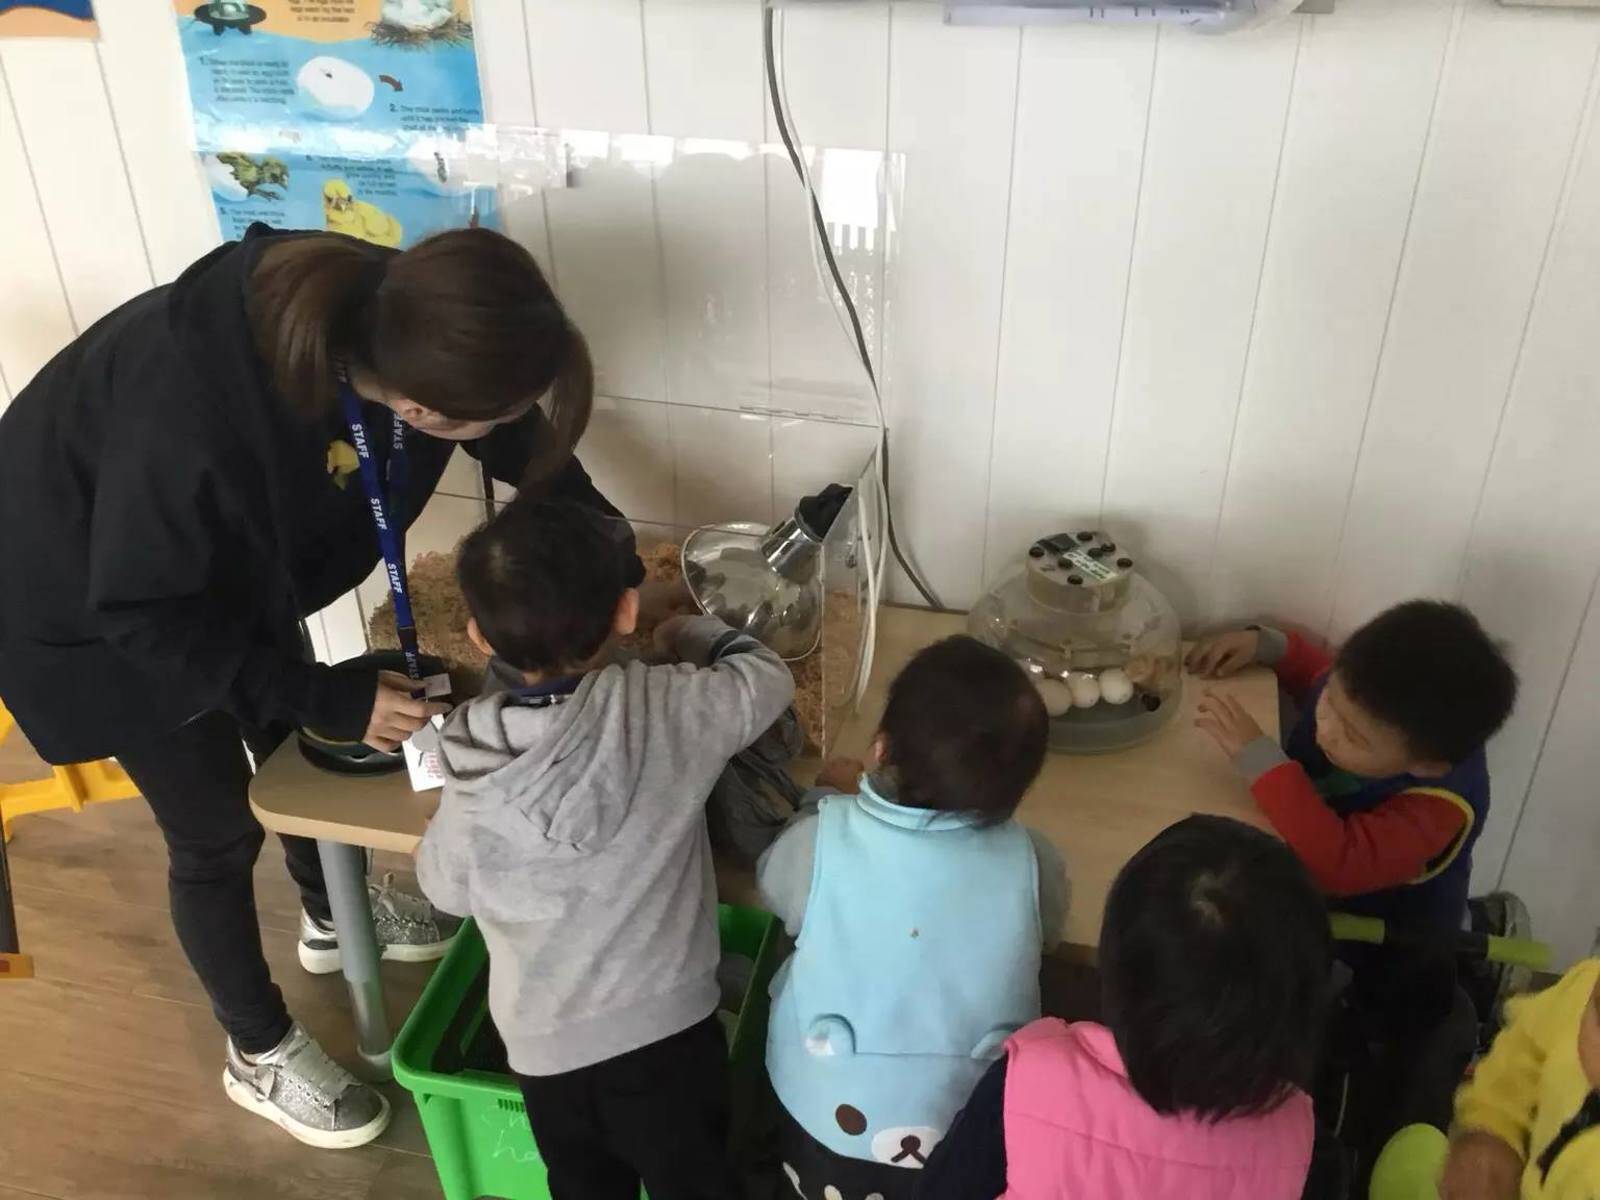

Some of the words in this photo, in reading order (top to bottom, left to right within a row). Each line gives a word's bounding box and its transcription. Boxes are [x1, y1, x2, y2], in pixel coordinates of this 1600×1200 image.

[351, 423, 369, 458] STAFF
[370, 498, 388, 530] STAFF
[387, 563, 403, 594] STAFF
